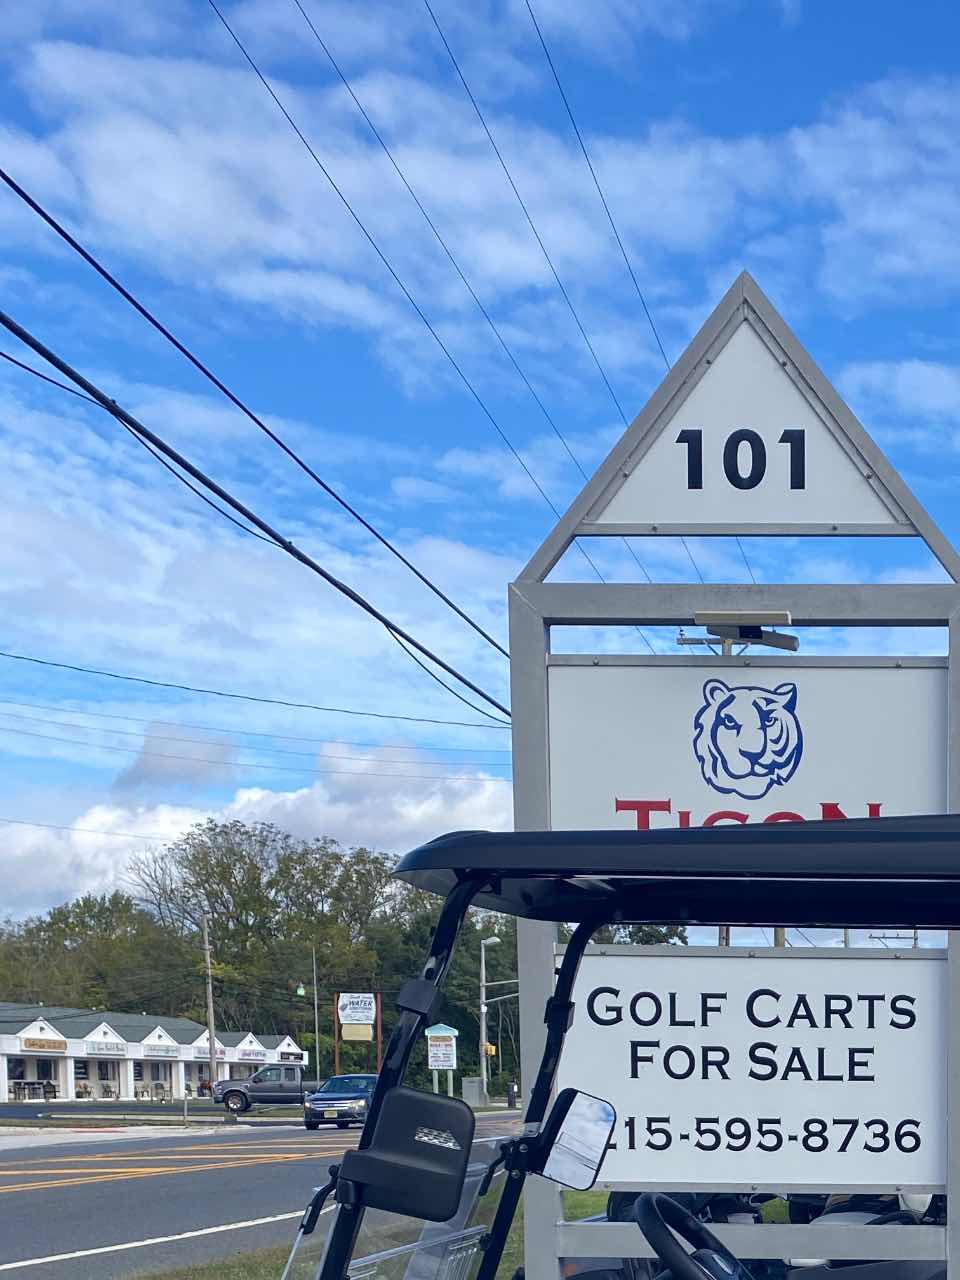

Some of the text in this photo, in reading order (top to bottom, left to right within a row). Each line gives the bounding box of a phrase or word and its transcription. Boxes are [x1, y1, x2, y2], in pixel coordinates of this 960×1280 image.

[674, 428, 806, 491] 101
[586, 986, 917, 1030] GOLF CARTS
[629, 1040, 876, 1082] FOR SALE
[607, 1116, 922, 1154] 15-595-8736
